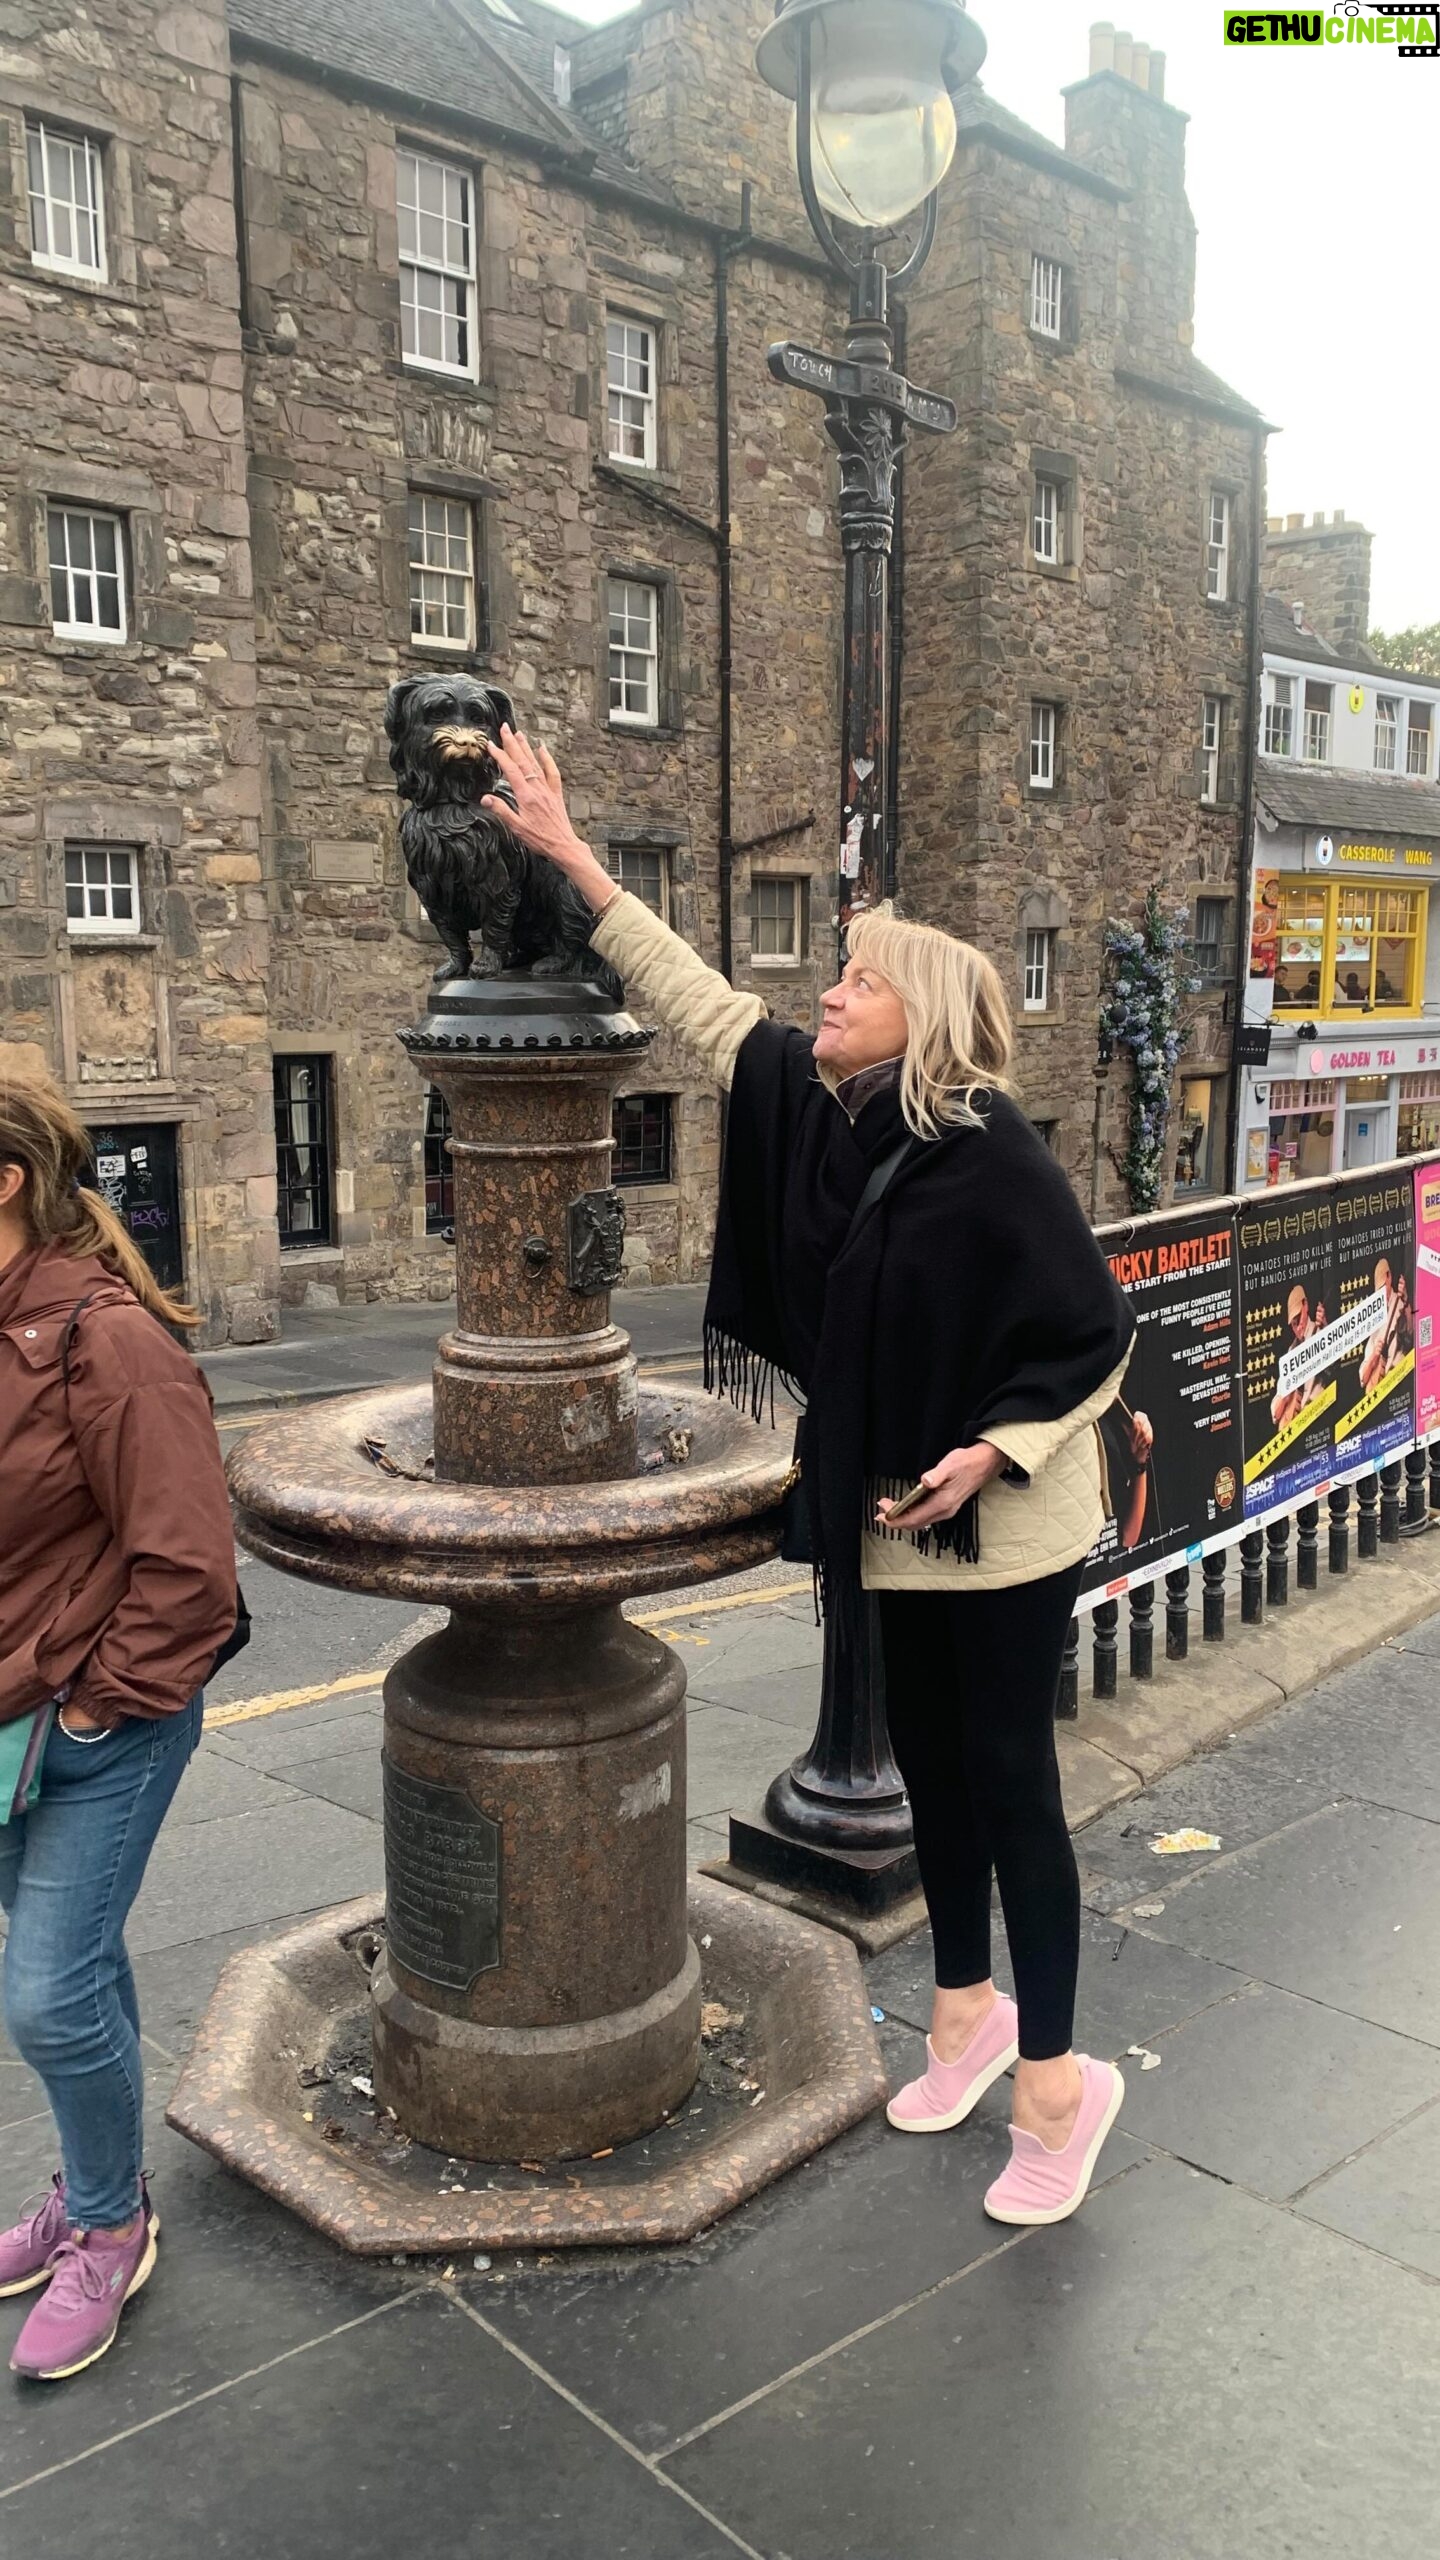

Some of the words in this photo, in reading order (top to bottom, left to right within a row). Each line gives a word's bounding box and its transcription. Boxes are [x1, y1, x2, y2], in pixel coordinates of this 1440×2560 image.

[788, 351, 832, 382] TOUCH
[1339, 844, 1395, 863] CASSEROLE
[1405, 849, 1432, 865] WANG
[1330, 1051, 1371, 1069] GOLDEN
[1377, 1050, 1395, 1066] TEA
[100, 1131, 113, 1143] 36
[1338, 1231, 1368, 1249] TOMATOES
[1370, 1227, 1385, 1240] TRIED
[1386, 1224, 1393, 1235] TO
[1395, 1221, 1406, 1233] KILL
[1339, 1250, 1350, 1263] BUT
[1352, 1243, 1373, 1260] BANJOS
[1375, 1238, 1391, 1253] SAVED
[1393, 1236, 1401, 1246] MY
[1402, 1231, 1412, 1244] LIFE
[1158, 1230, 1231, 1275] BARTLETT
[1243, 1256, 1281, 1276] TOMATOES
[1283, 1251, 1300, 1266] TRIED
[1302, 1248, 1310, 1260] TO
[1311, 1244, 1325, 1257] KILL
[1325, 1241, 1333, 1253] ME
[1135, 1275, 1161, 1291] START
[1163, 1268, 1187, 1283] FROM
[1188, 1265, 1205, 1277] THE
[1206, 1257, 1231, 1272] START!
[1244, 1277, 1258, 1291] BUT
[1260, 1269, 1287, 1287] BANJOS
[1289, 1263, 1307, 1279] SAVED
[1309, 1261, 1318, 1272] MY
[1320, 1256, 1332, 1269] LIFE
[1151, 1310, 1159, 1320] OF
[1160, 1306, 1172, 1317] THE
[1173, 1301, 1190, 1313] MOST
[1191, 1289, 1232, 1308] CONSISTENTLY
[1161, 1313, 1181, 1327] FUNNY
[1183, 1307, 1205, 1320] PEOPLE
[1205, 1303, 1216, 1314] I'VE
[1217, 1298, 1231, 1310] EVER
[1191, 1313, 1215, 1327] WORKED
[1282, 1363, 1288, 1377] 3
[1290, 1337, 1326, 1372] EVENING
[1327, 1316, 1356, 1346] SHOWS
[1357, 1295, 1385, 1326] ADDED!
[1182, 1344, 1204, 1359] KILLED,
[1188, 1358, 1191, 1366] I
[1191, 1352, 1210, 1365] DIDN'T
[1292, 1359, 1322, 1385] Symposium
[1322, 1350, 1333, 1362] Hall
[1344, 1335, 1354, 1348] Aug
[1321, 1453, 1329, 1465] 53
